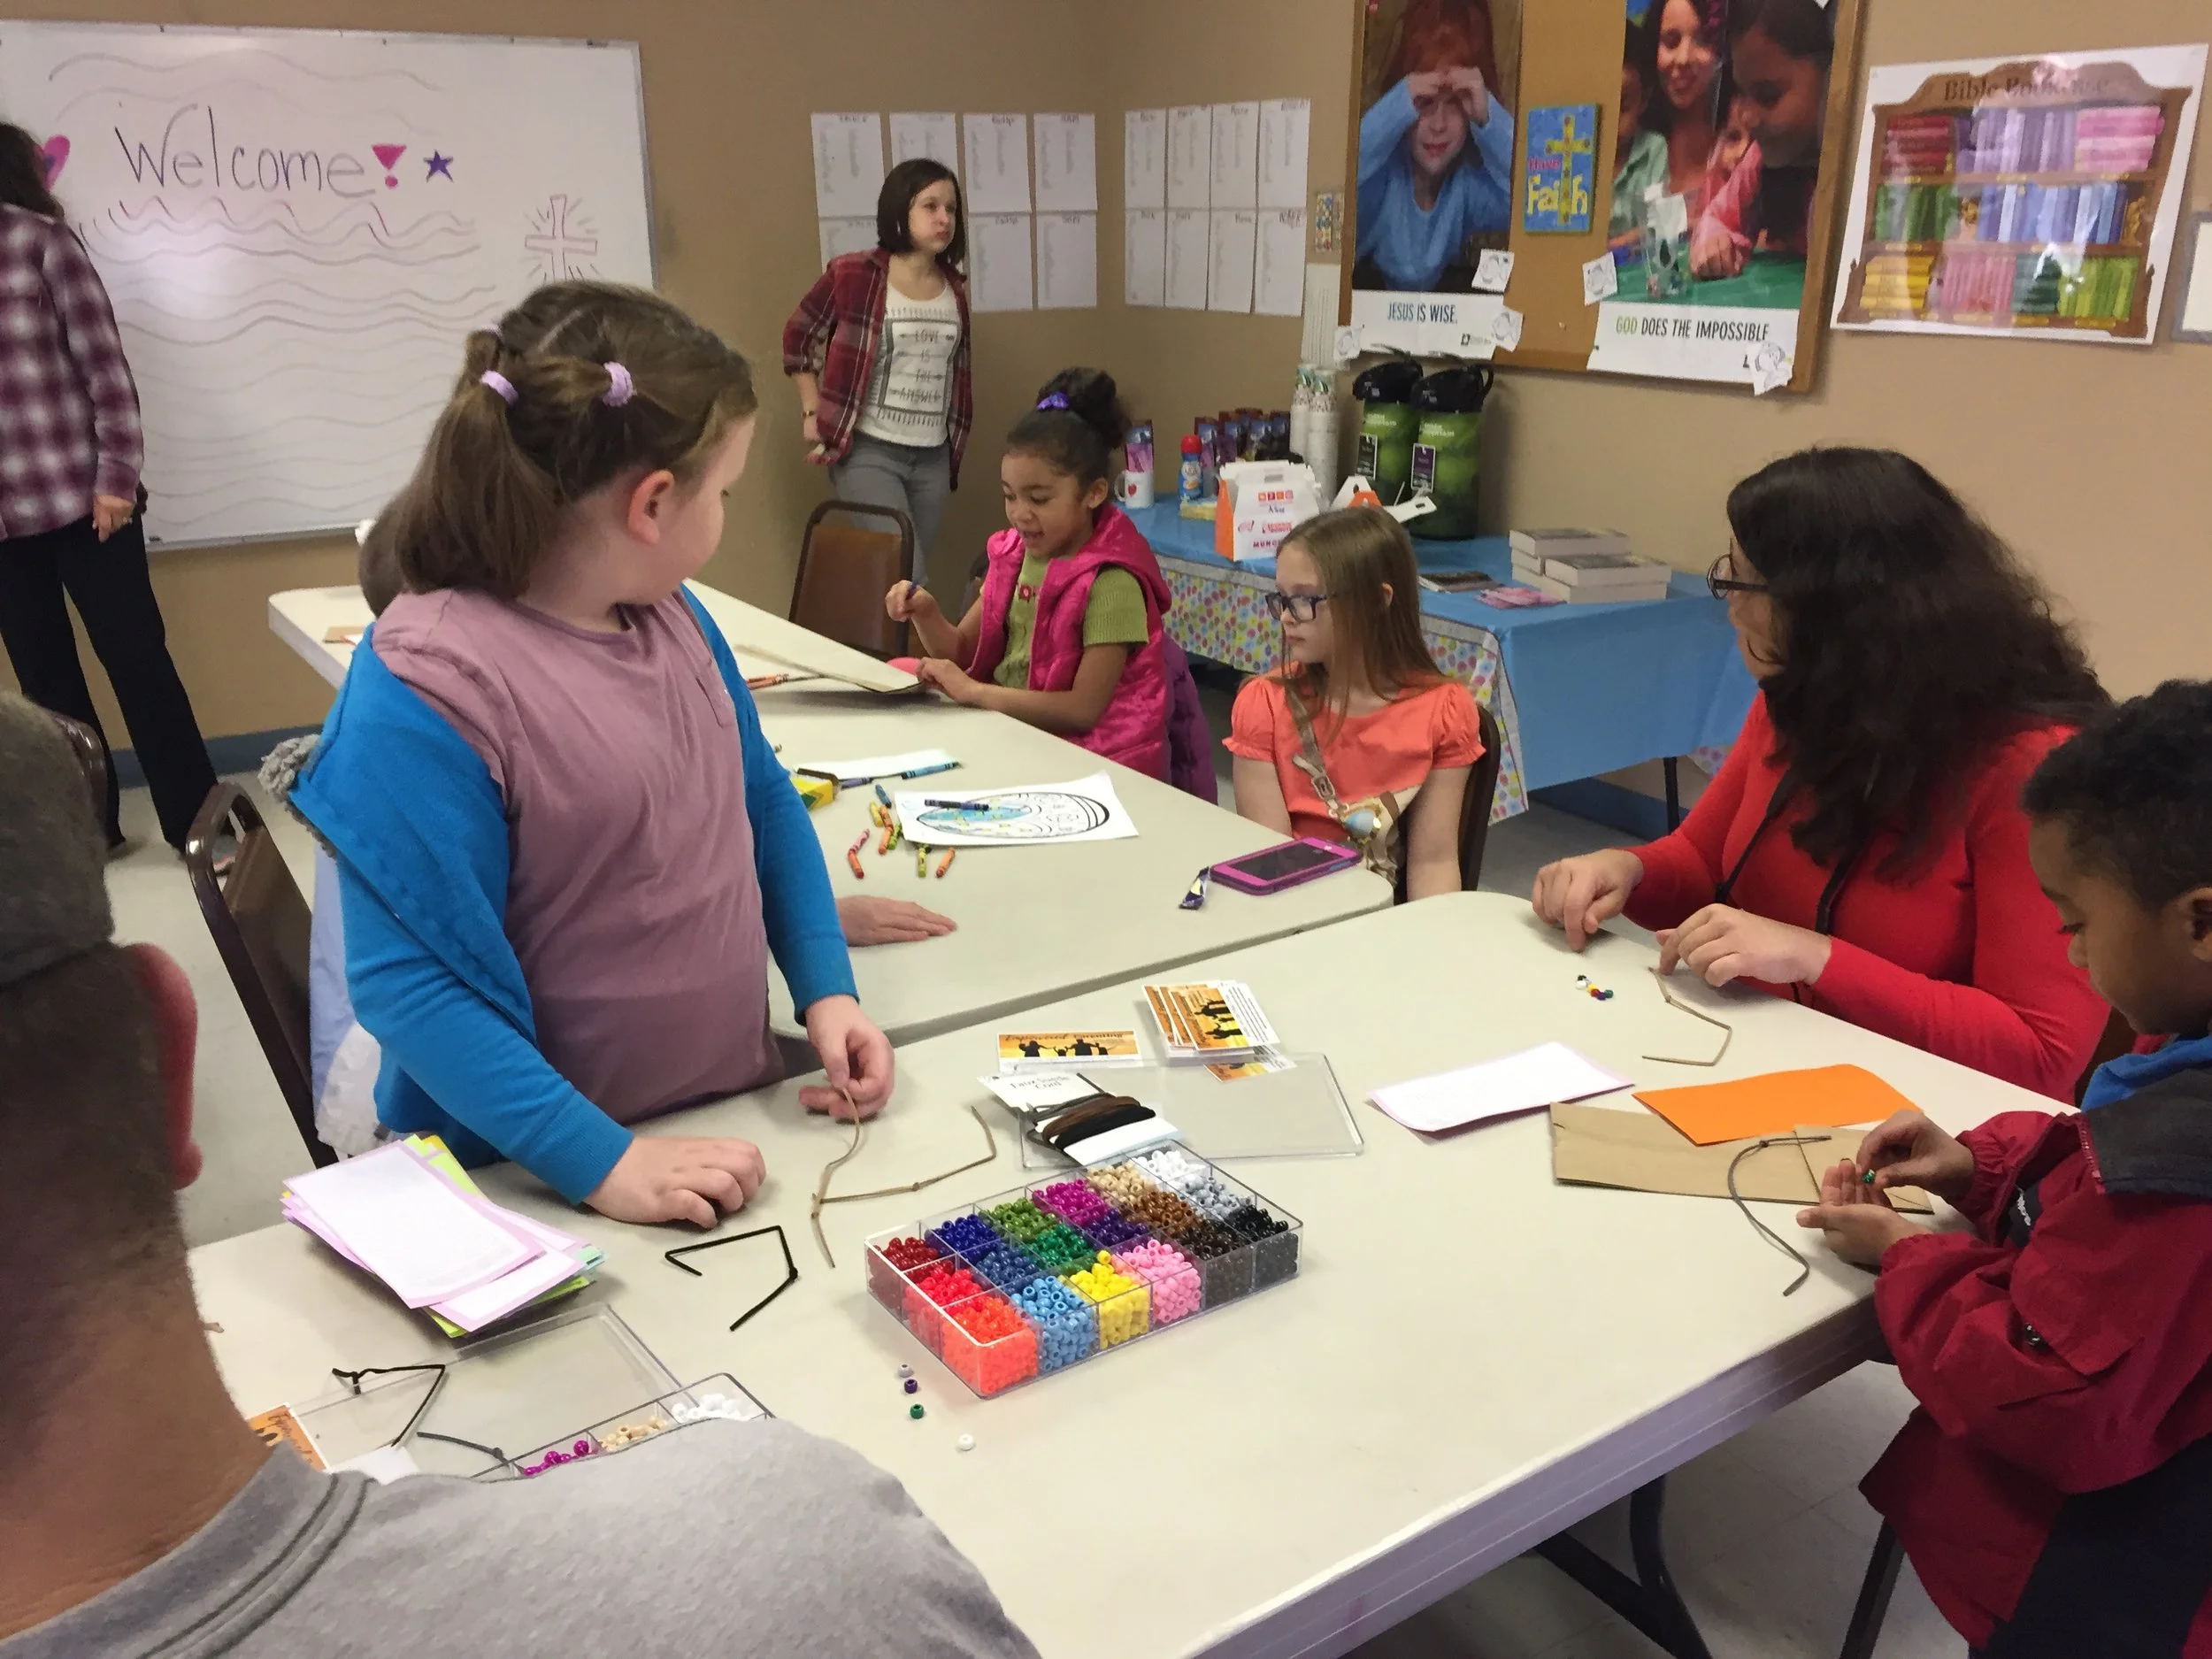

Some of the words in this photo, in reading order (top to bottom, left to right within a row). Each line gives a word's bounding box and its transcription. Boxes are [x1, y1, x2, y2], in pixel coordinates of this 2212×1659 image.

[1944, 75, 2000, 101] Bible
[1527, 173, 1588, 216] Faith
[1387, 301, 1414, 321] JESUS
[1417, 303, 1426, 323] IS
[1430, 303, 1458, 325] WISE.
[1616, 315, 1637, 335] GOD
[1641, 317, 1668, 337] DOES
[1671, 318, 1693, 339] THE
[1695, 319, 1770, 342] IMPOSSIBLE
